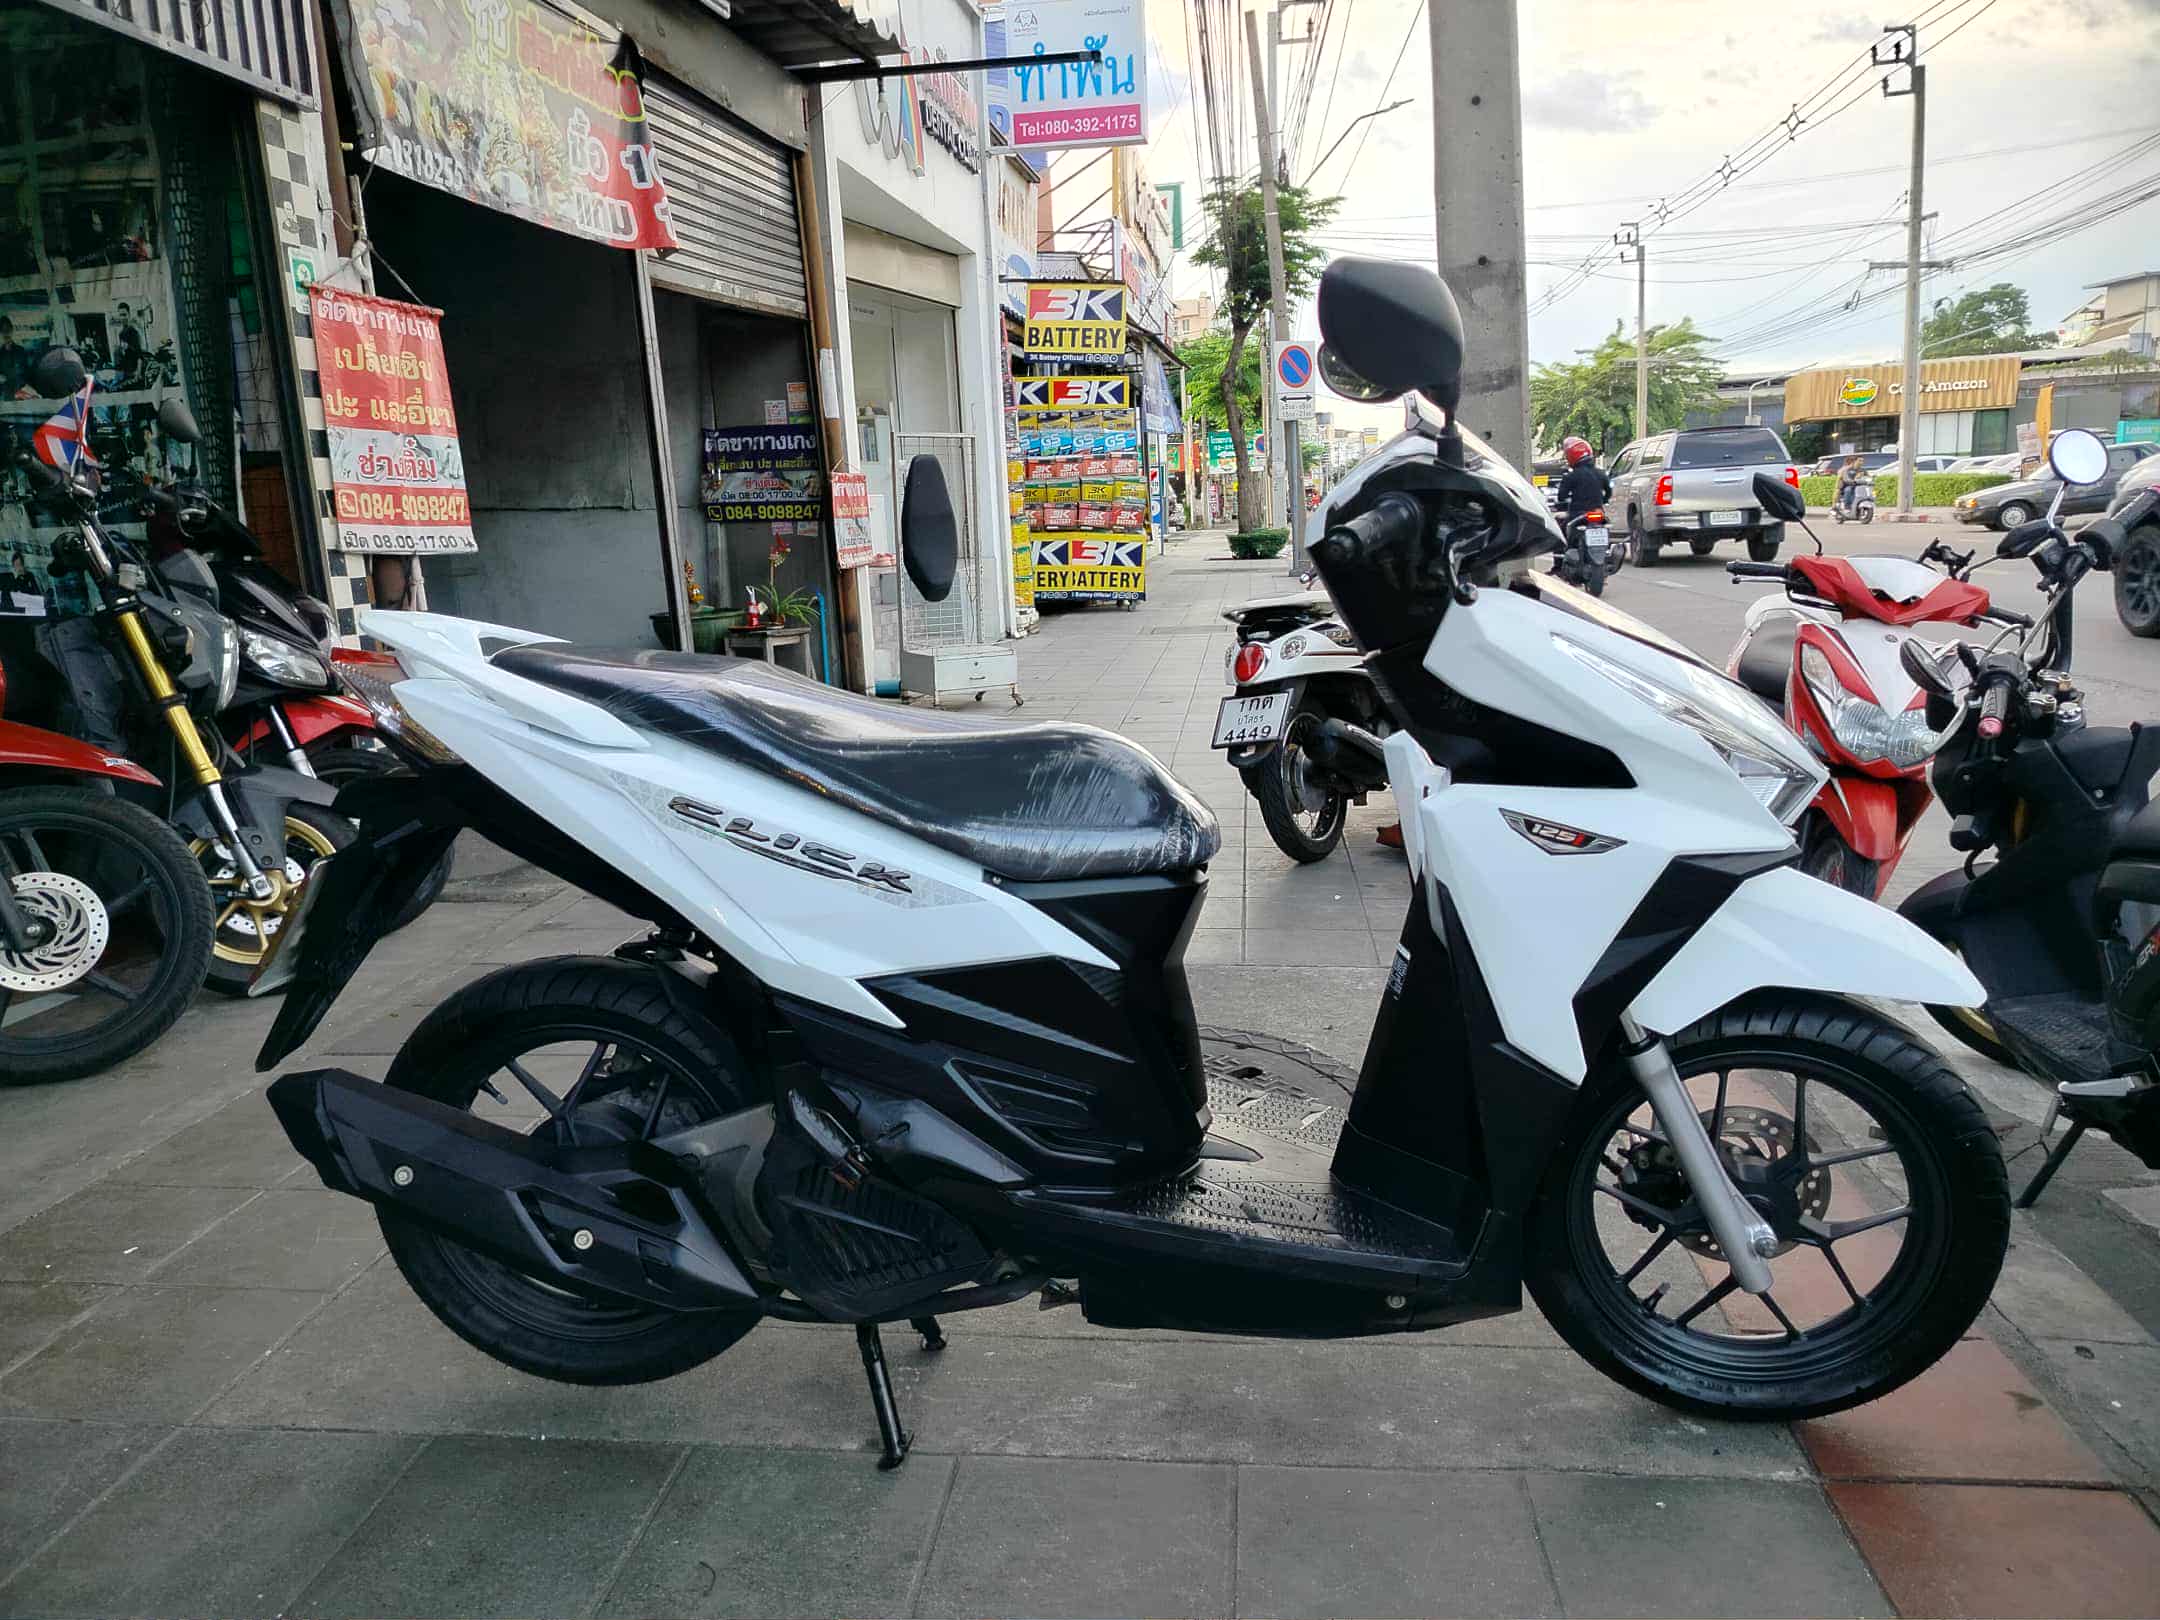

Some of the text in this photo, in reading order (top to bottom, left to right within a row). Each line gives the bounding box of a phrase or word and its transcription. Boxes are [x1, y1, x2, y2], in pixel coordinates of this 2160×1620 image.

[1019, 114, 1137, 137] Tel:080-392-1175
[317, 289, 437, 340] ตัดขากางเกง
[1033, 289, 1122, 320] 3K
[1028, 326, 1122, 348] BATTERY
[1055, 381, 1123, 405] 3K
[1925, 379, 1989, 393] Amazon
[326, 388, 359, 418] ปะ
[705, 431, 818, 453] ตัดขากางเกง
[1041, 433, 1061, 447] GS
[1073, 433, 1095, 448] GS
[1105, 433, 1127, 448] GS
[1088, 461, 1105, 469] 3K
[360, 492, 466, 521] 084-9098247
[725, 504, 820, 519] 084-9098247
[1049, 510, 1070, 518] 3K
[1088, 511, 1105, 519] 3K
[1118, 510, 1138, 519] 3K
[372, 534, 458, 549] 08.00-17.00
[1072, 541, 1141, 567] 3K
[1223, 725, 1272, 741] 4449
[667, 796, 913, 893] CLICK
[1532, 823, 1584, 846] 125i
